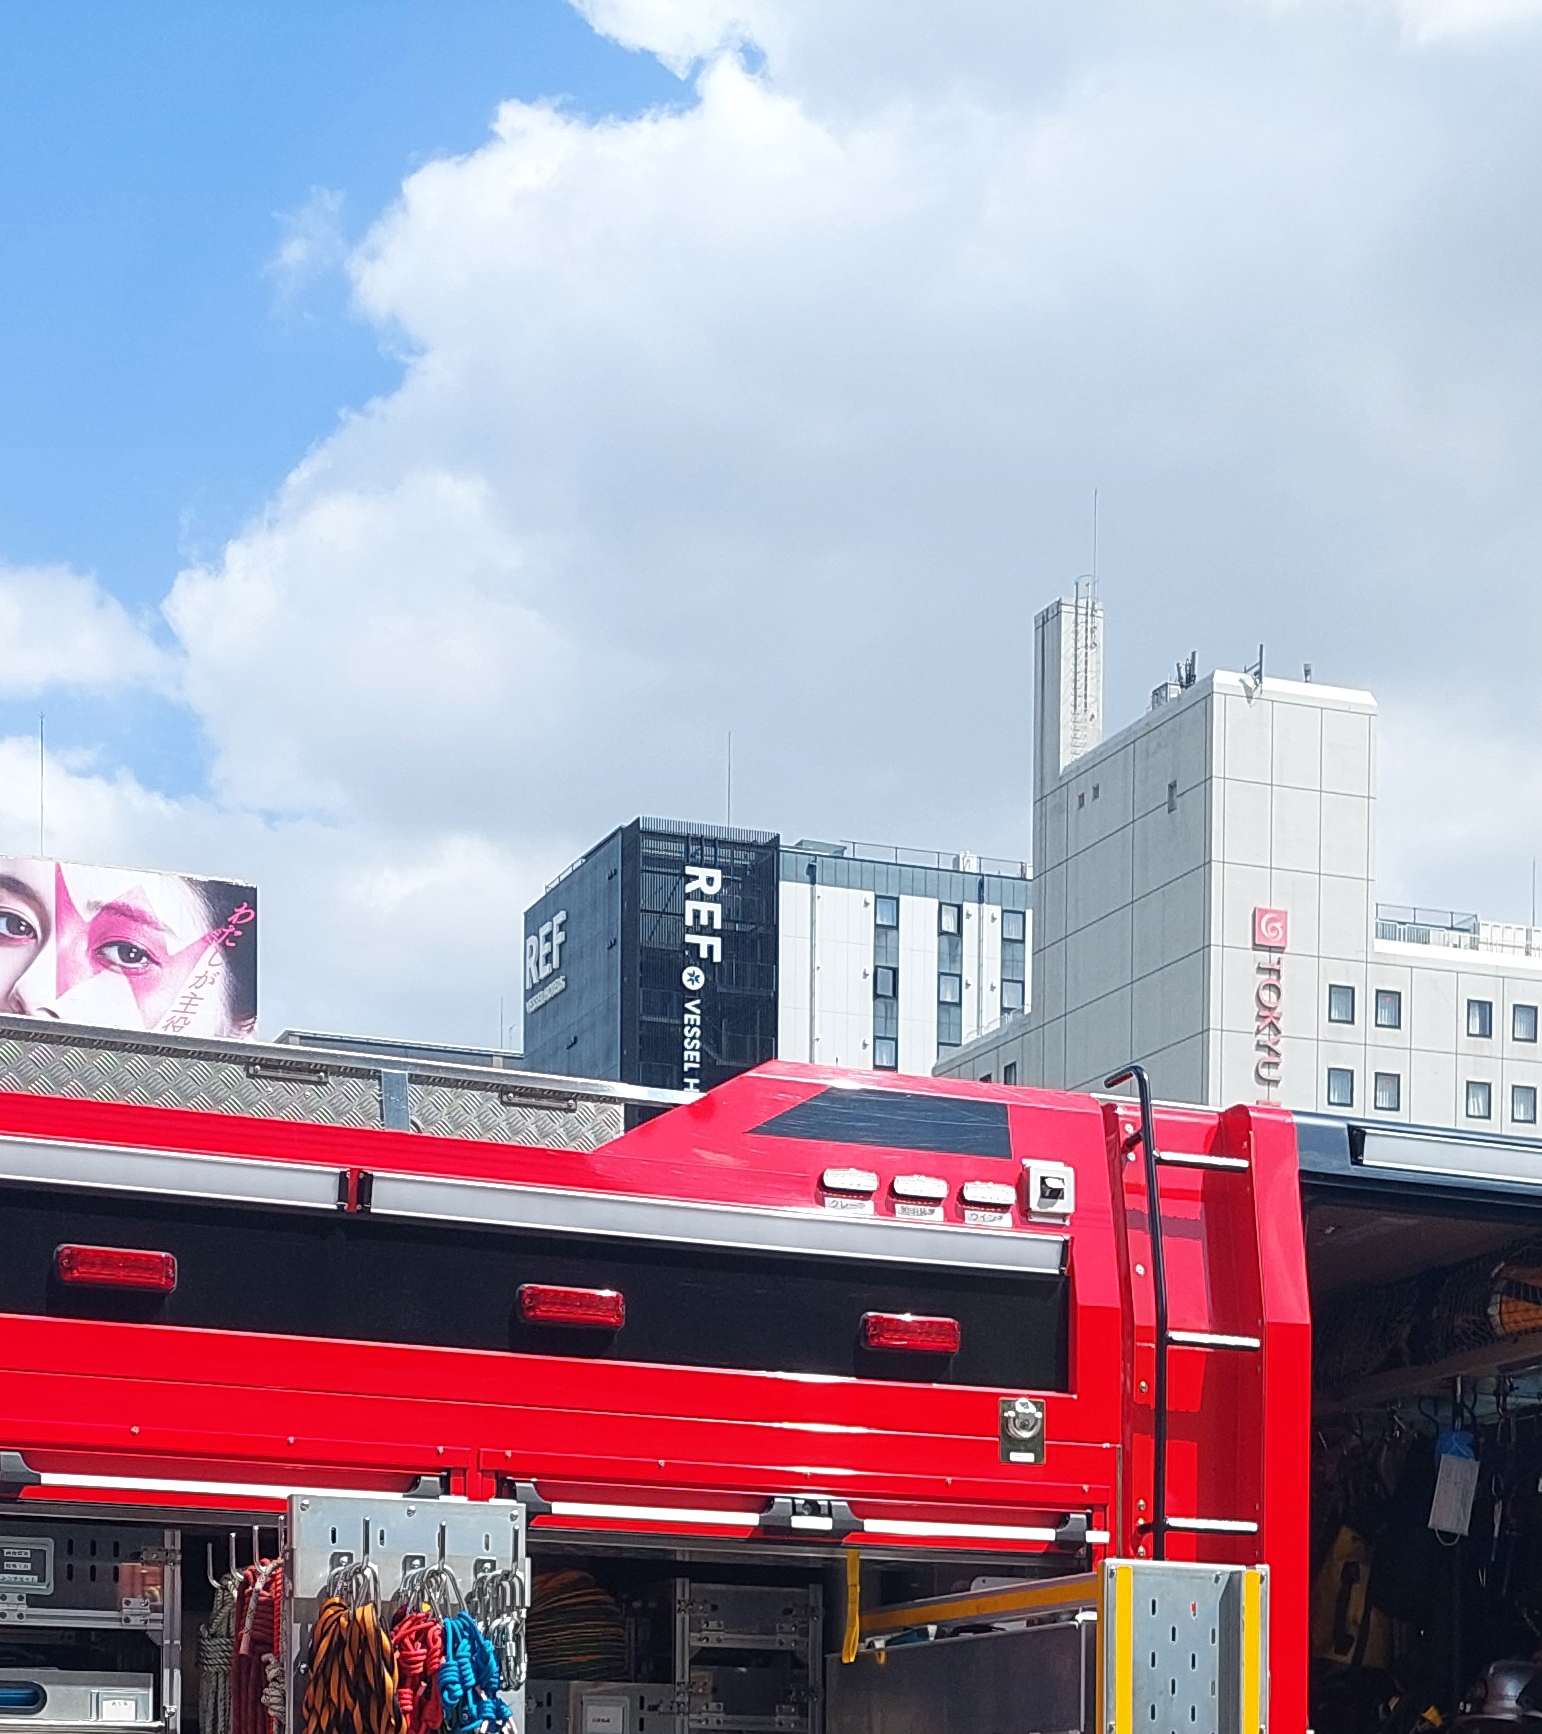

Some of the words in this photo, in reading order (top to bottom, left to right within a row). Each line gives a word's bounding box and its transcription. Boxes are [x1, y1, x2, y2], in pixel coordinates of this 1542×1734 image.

[525, 909, 567, 990] REF
[684, 865, 722, 963] REF
[162, 901, 256, 1033] わたしが主役
[683, 1000, 701, 1072] VESSEL
[1256, 956, 1283, 1088] TOKYU
